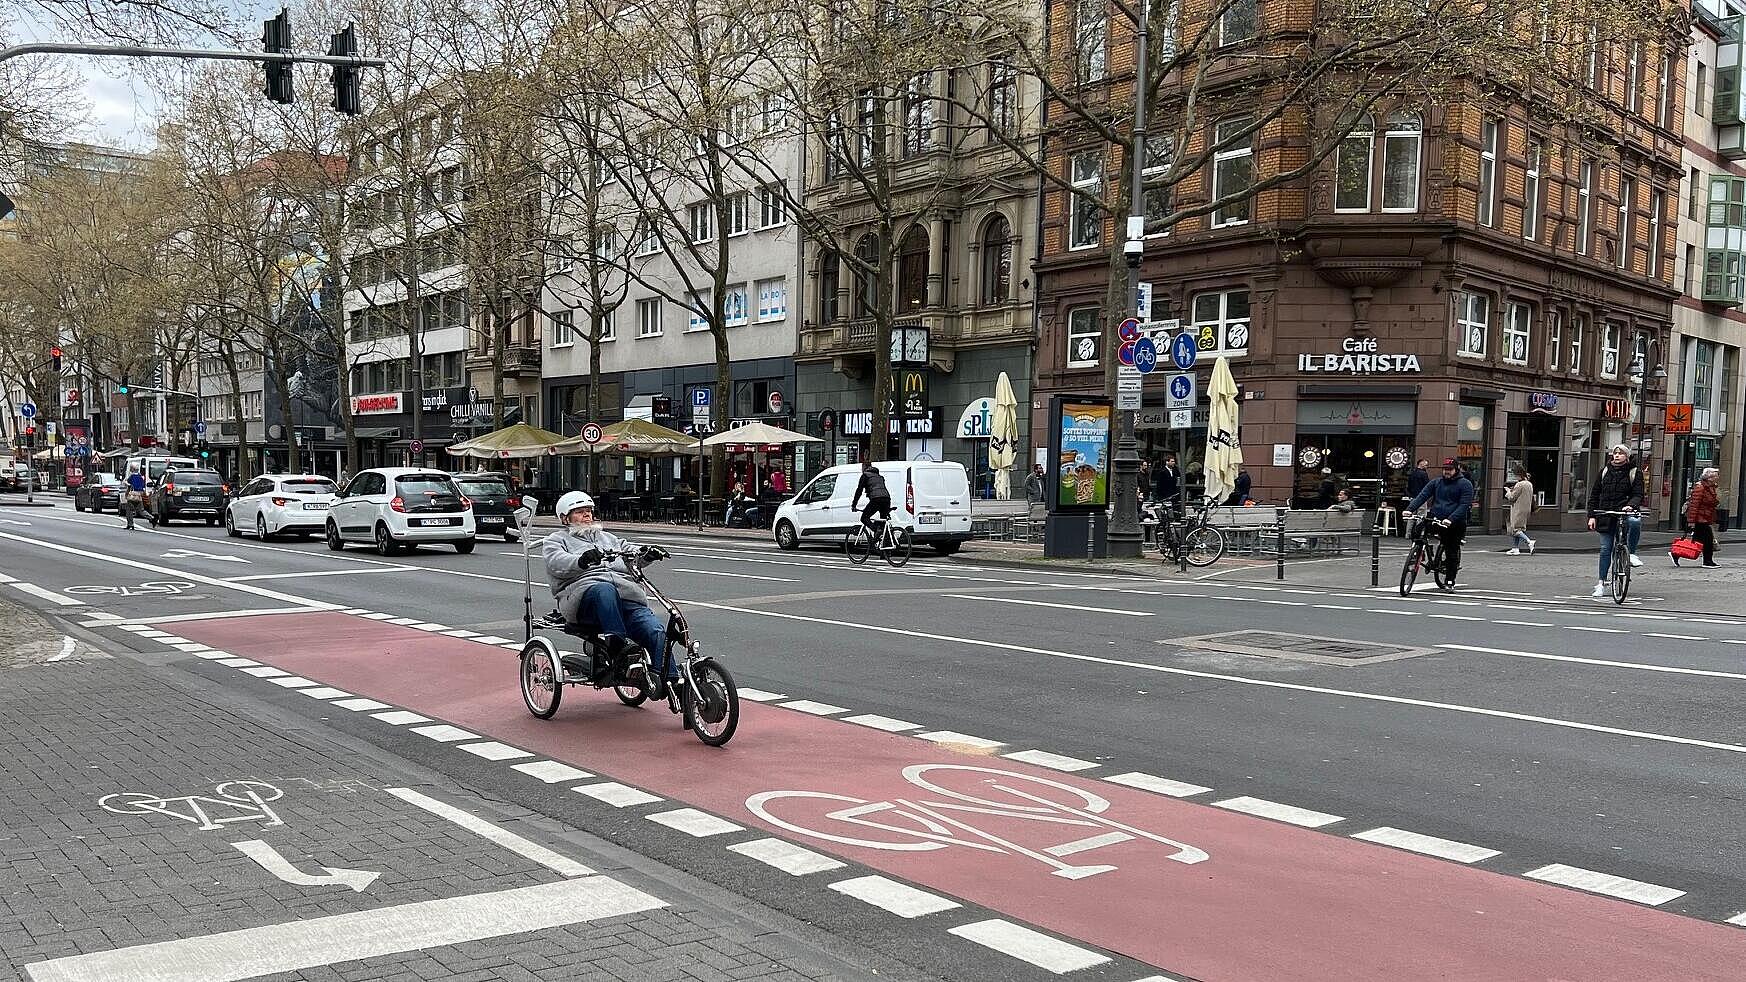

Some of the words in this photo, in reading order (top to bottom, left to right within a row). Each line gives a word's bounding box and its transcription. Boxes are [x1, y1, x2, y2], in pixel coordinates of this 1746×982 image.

[1342, 338, 1378, 352] Café
[1298, 354, 1318, 371] IL
[1324, 354, 1421, 371] BARISTA
[696, 391, 706, 404] P
[1532, 393, 1558, 407] COSMO
[451, 404, 470, 418] CHILLI
[845, 413, 872, 434] HAUS
[1143, 414, 1161, 424] Café
[585, 429, 599, 439] 30
